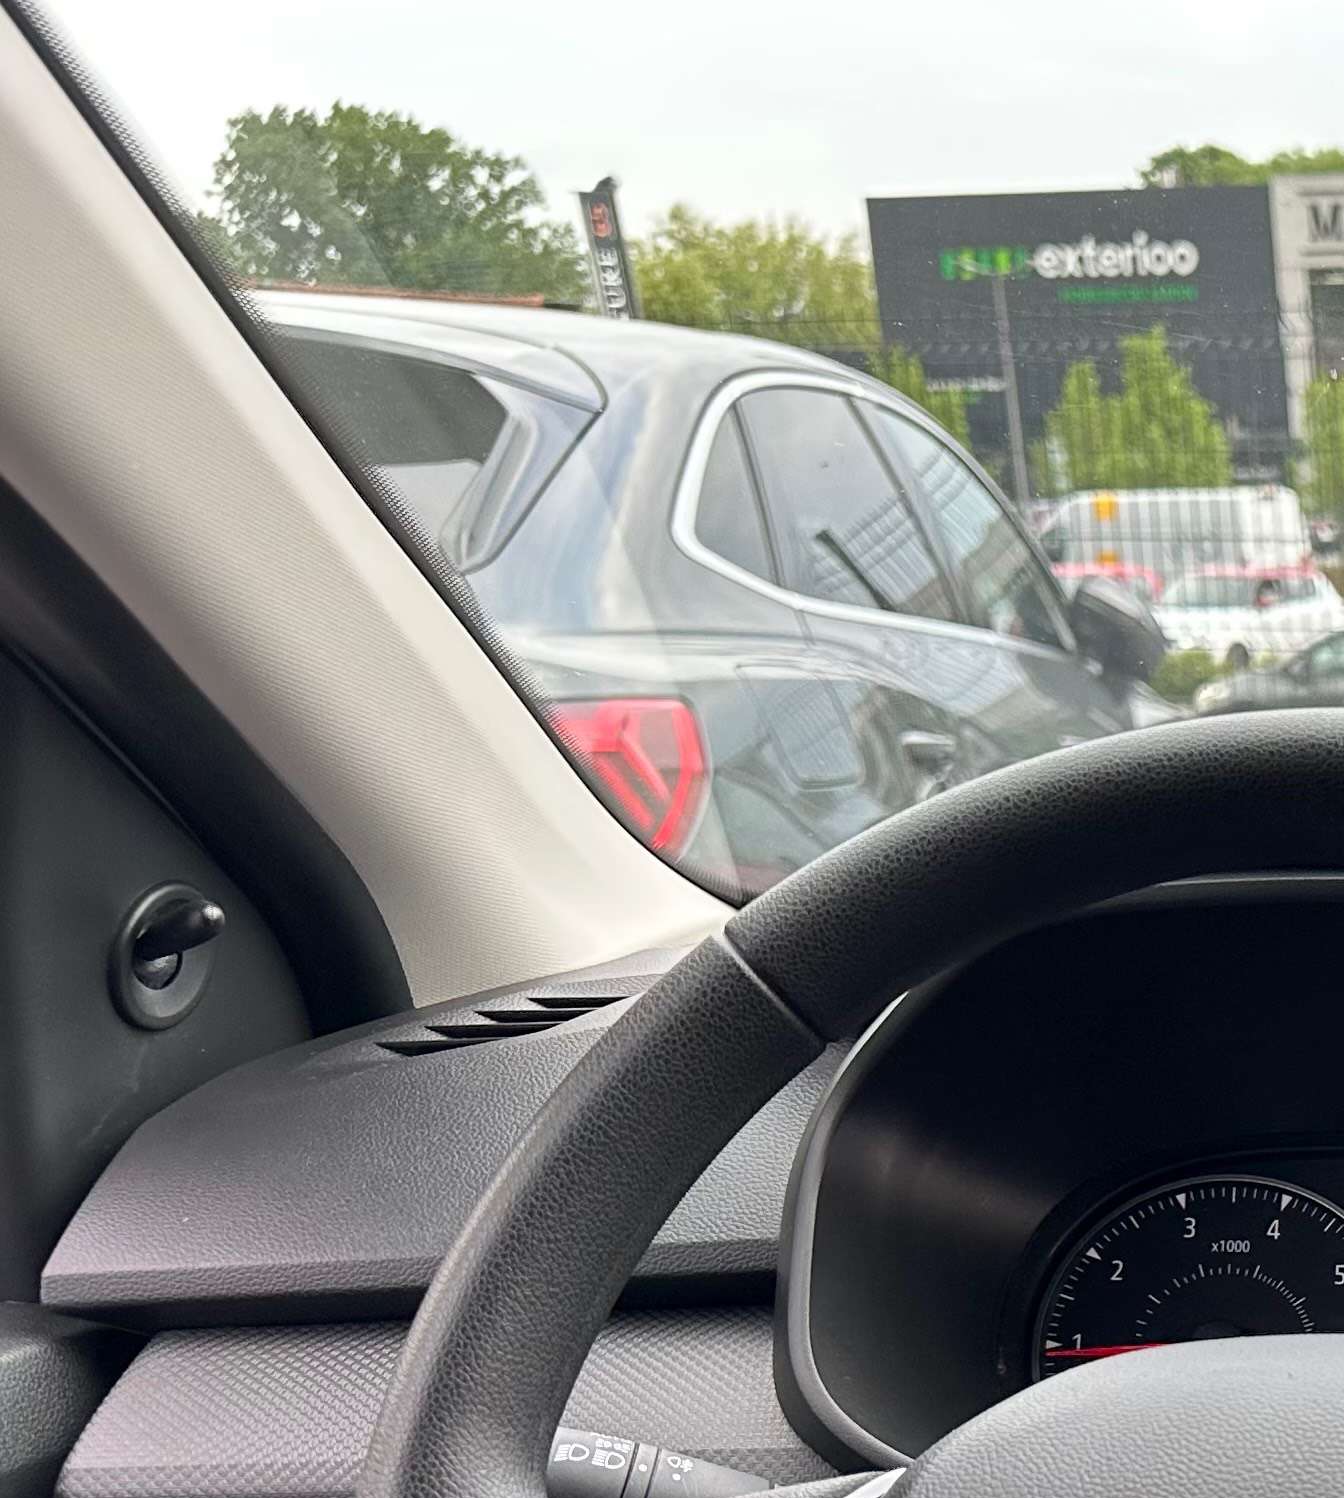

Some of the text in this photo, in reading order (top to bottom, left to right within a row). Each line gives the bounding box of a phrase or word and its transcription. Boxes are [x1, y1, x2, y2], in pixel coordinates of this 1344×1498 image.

[1033, 230, 1199, 278] exterioo
[1183, 1217, 1196, 1238] 3
[1266, 1219, 1281, 1240] 4
[1211, 1239, 1251, 1254] x1000
[1110, 1259, 1124, 1281] 2
[1072, 1333, 1082, 1351] 1
